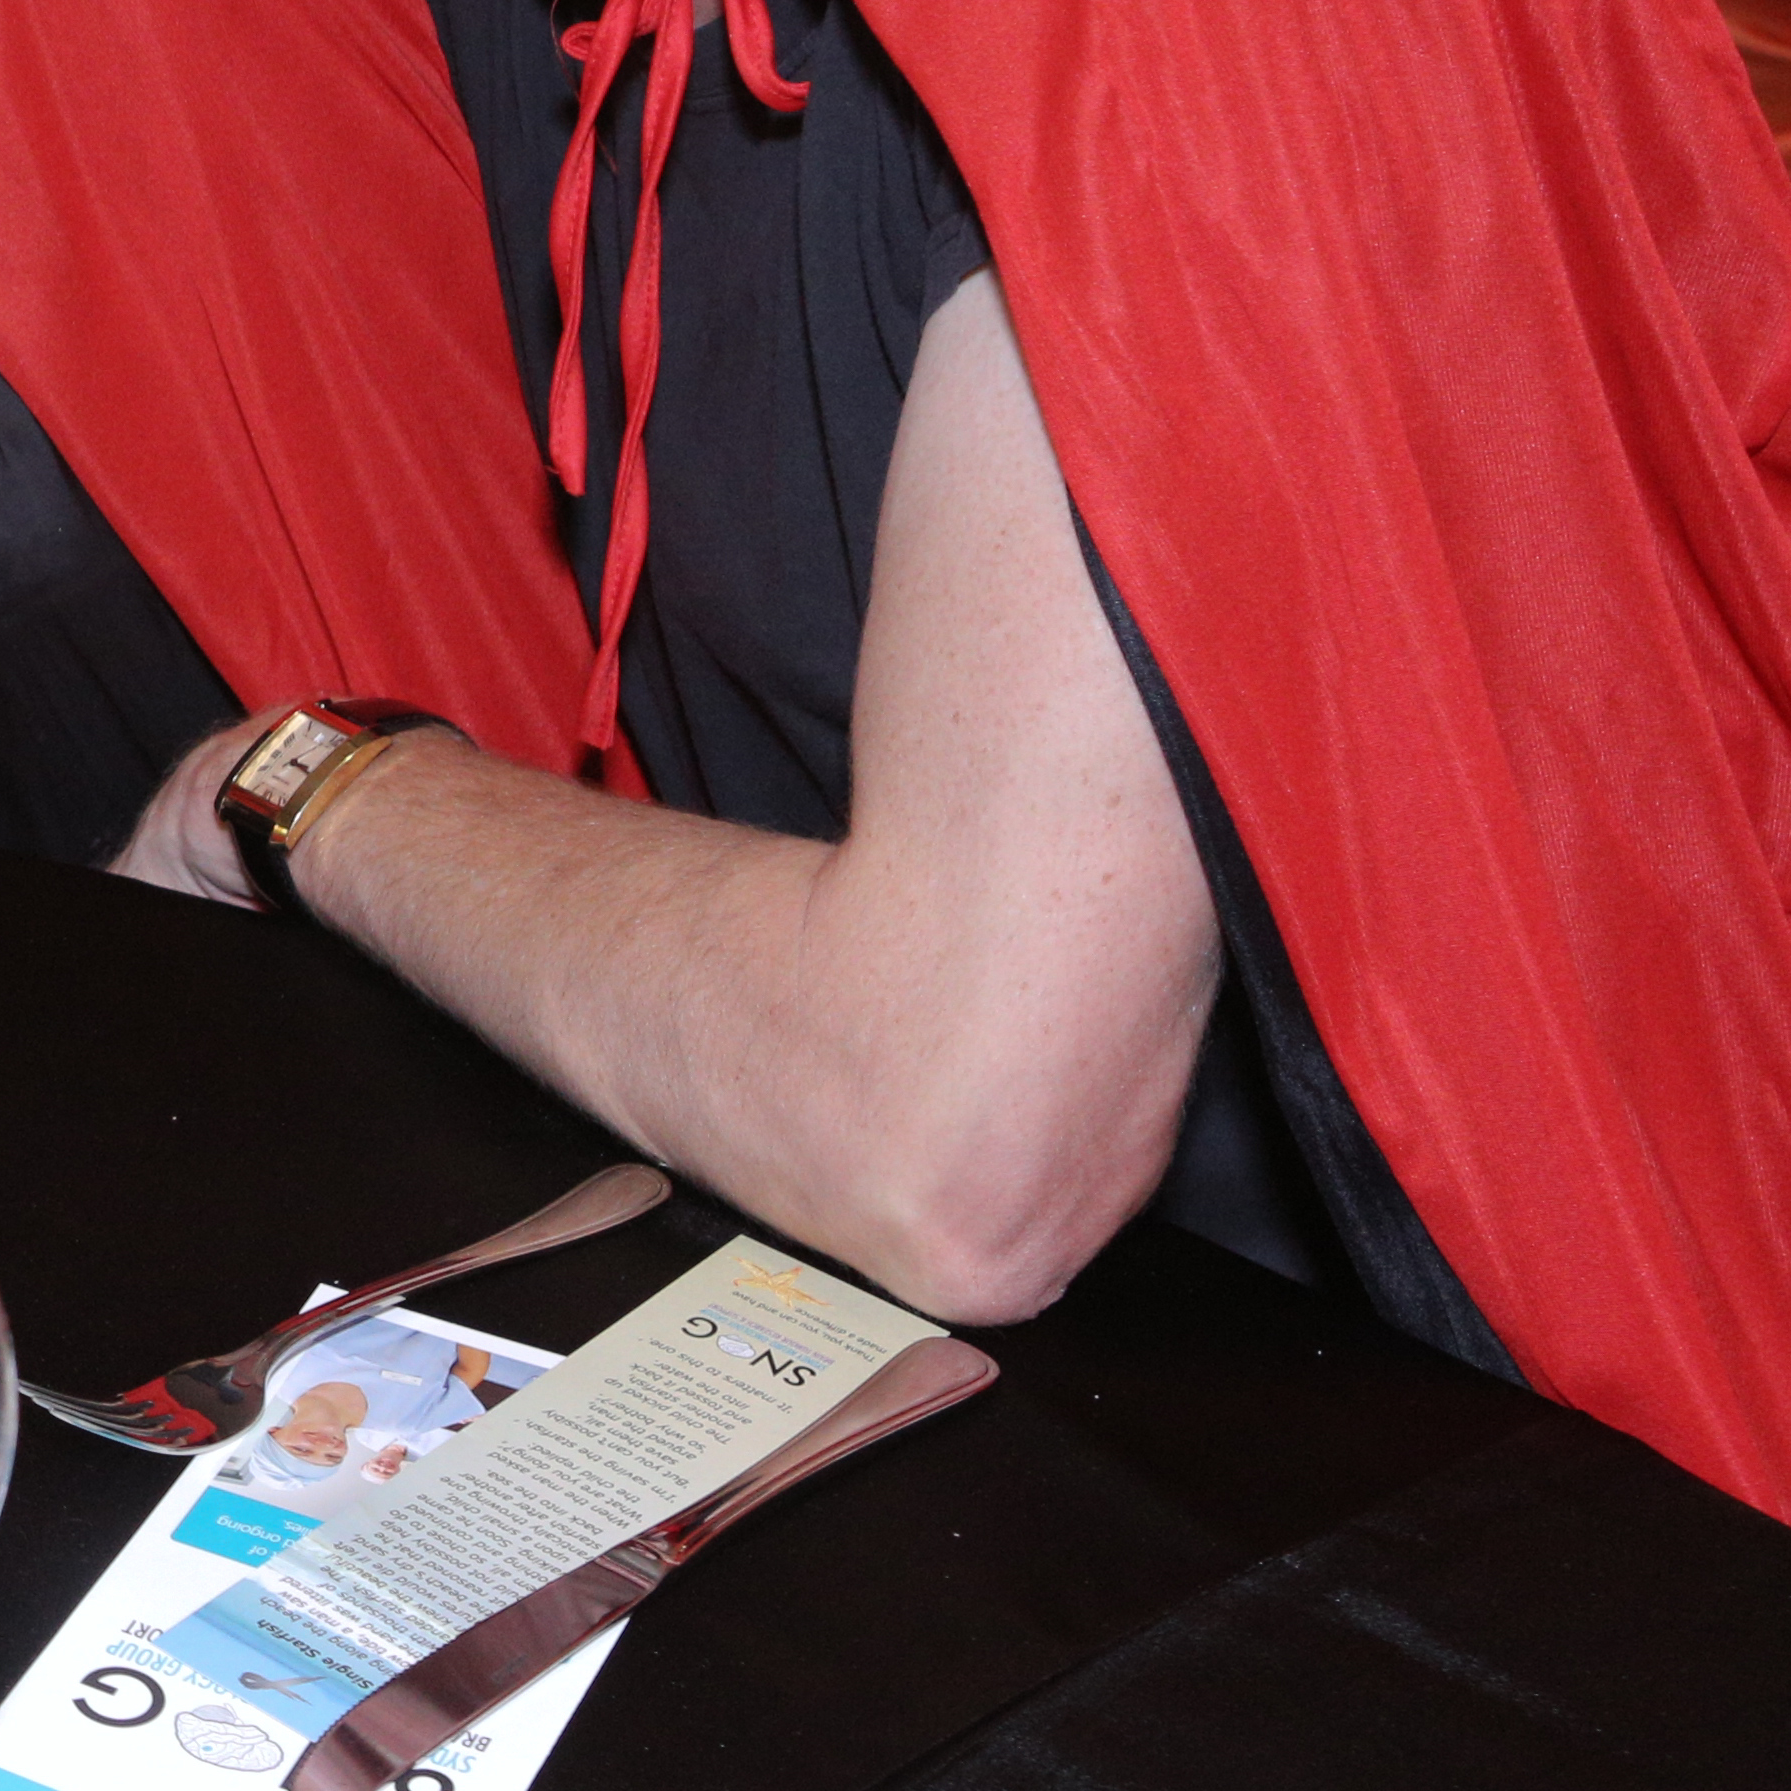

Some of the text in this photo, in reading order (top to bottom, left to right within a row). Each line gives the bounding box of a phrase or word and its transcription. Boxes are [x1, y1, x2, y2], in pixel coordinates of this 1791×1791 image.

[731, 1290, 757, 1306] have
[755, 1302, 779, 1315] and
[778, 1312, 799, 1324] can
[798, 1322, 820, 1335] you
[843, 1343, 876, 1363] Thank
[856, 1337, 888, 1355] made
[676, 1353, 705, 1369] this
[705, 1366, 722, 1377] to
[630, 1363, 753, 1425] and tossed it back
[695, 1381, 721, 1396] the
[722, 1375, 777, 1404] matters
[603, 1377, 732, 1445] The child picked up
[721, 1394, 751, 1411] into
[542, 1409, 601, 1438] possibly
[680, 1403, 736, 1431] another
[621, 1420, 647, 1435] the
[655, 1424, 686, 1441] why
[577, 1447, 603, 1463] the
[606, 1427, 679, 1466] save them
[644, 1433, 697, 1460] argued
[603, 1460, 650, 1486] saving
[633, 1455, 665, 1472] you
[551, 1469, 586, 1489] you
[578, 1470, 615, 1489] child
[486, 1451, 631, 1530] When the man asked
[513, 1485, 539, 1501] the
[583, 1486, 606, 1499] are
[615, 1488, 641, 1504] the
[439, 1476, 529, 1526] throwing one
[539, 1499, 569, 1517] into
[389, 1509, 409, 1521] do
[416, 1493, 513, 1548] Soon he came
[458, 1473, 603, 1550] starfish after another
[216, 1515, 283, 1547] ongoing
[409, 1520, 426, 1532] to
[479, 1514, 521, 1536] small
[567, 1515, 604, 1536] back
[404, 1503, 549, 1583] othing and continued
[426, 1529, 468, 1554] chose
[520, 1535, 534, 1543] a
[247, 1542, 272, 1558] of
[380, 1520, 496, 1585] not possibly help
[468, 1553, 488, 1565] so
[533, 1541, 571, 1564] upon
[333, 1540, 438, 1602] would die if left
[373, 1531, 507, 1608] ut reasoned that he
[389, 1556, 415, 1571] dry
[319, 1565, 347, 1584] The
[278, 1575, 333, 1607] littered
[315, 1582, 338, 1592] of
[324, 1553, 453, 1626] knew the beautiful
[278, 1591, 309, 1608] saw
[468, 1601, 494, 1617] the
[308, 1607, 341, 1628] man
[332, 1605, 362, 1623] was
[341, 1593, 409, 1634] thousands
[259, 1596, 369, 1660] along the beach
[341, 1626, 354, 1635] a
[359, 1622, 398, 1644] sand
[257, 1619, 374, 1689] Single Starfish
[387, 1654, 411, 1668] ow
